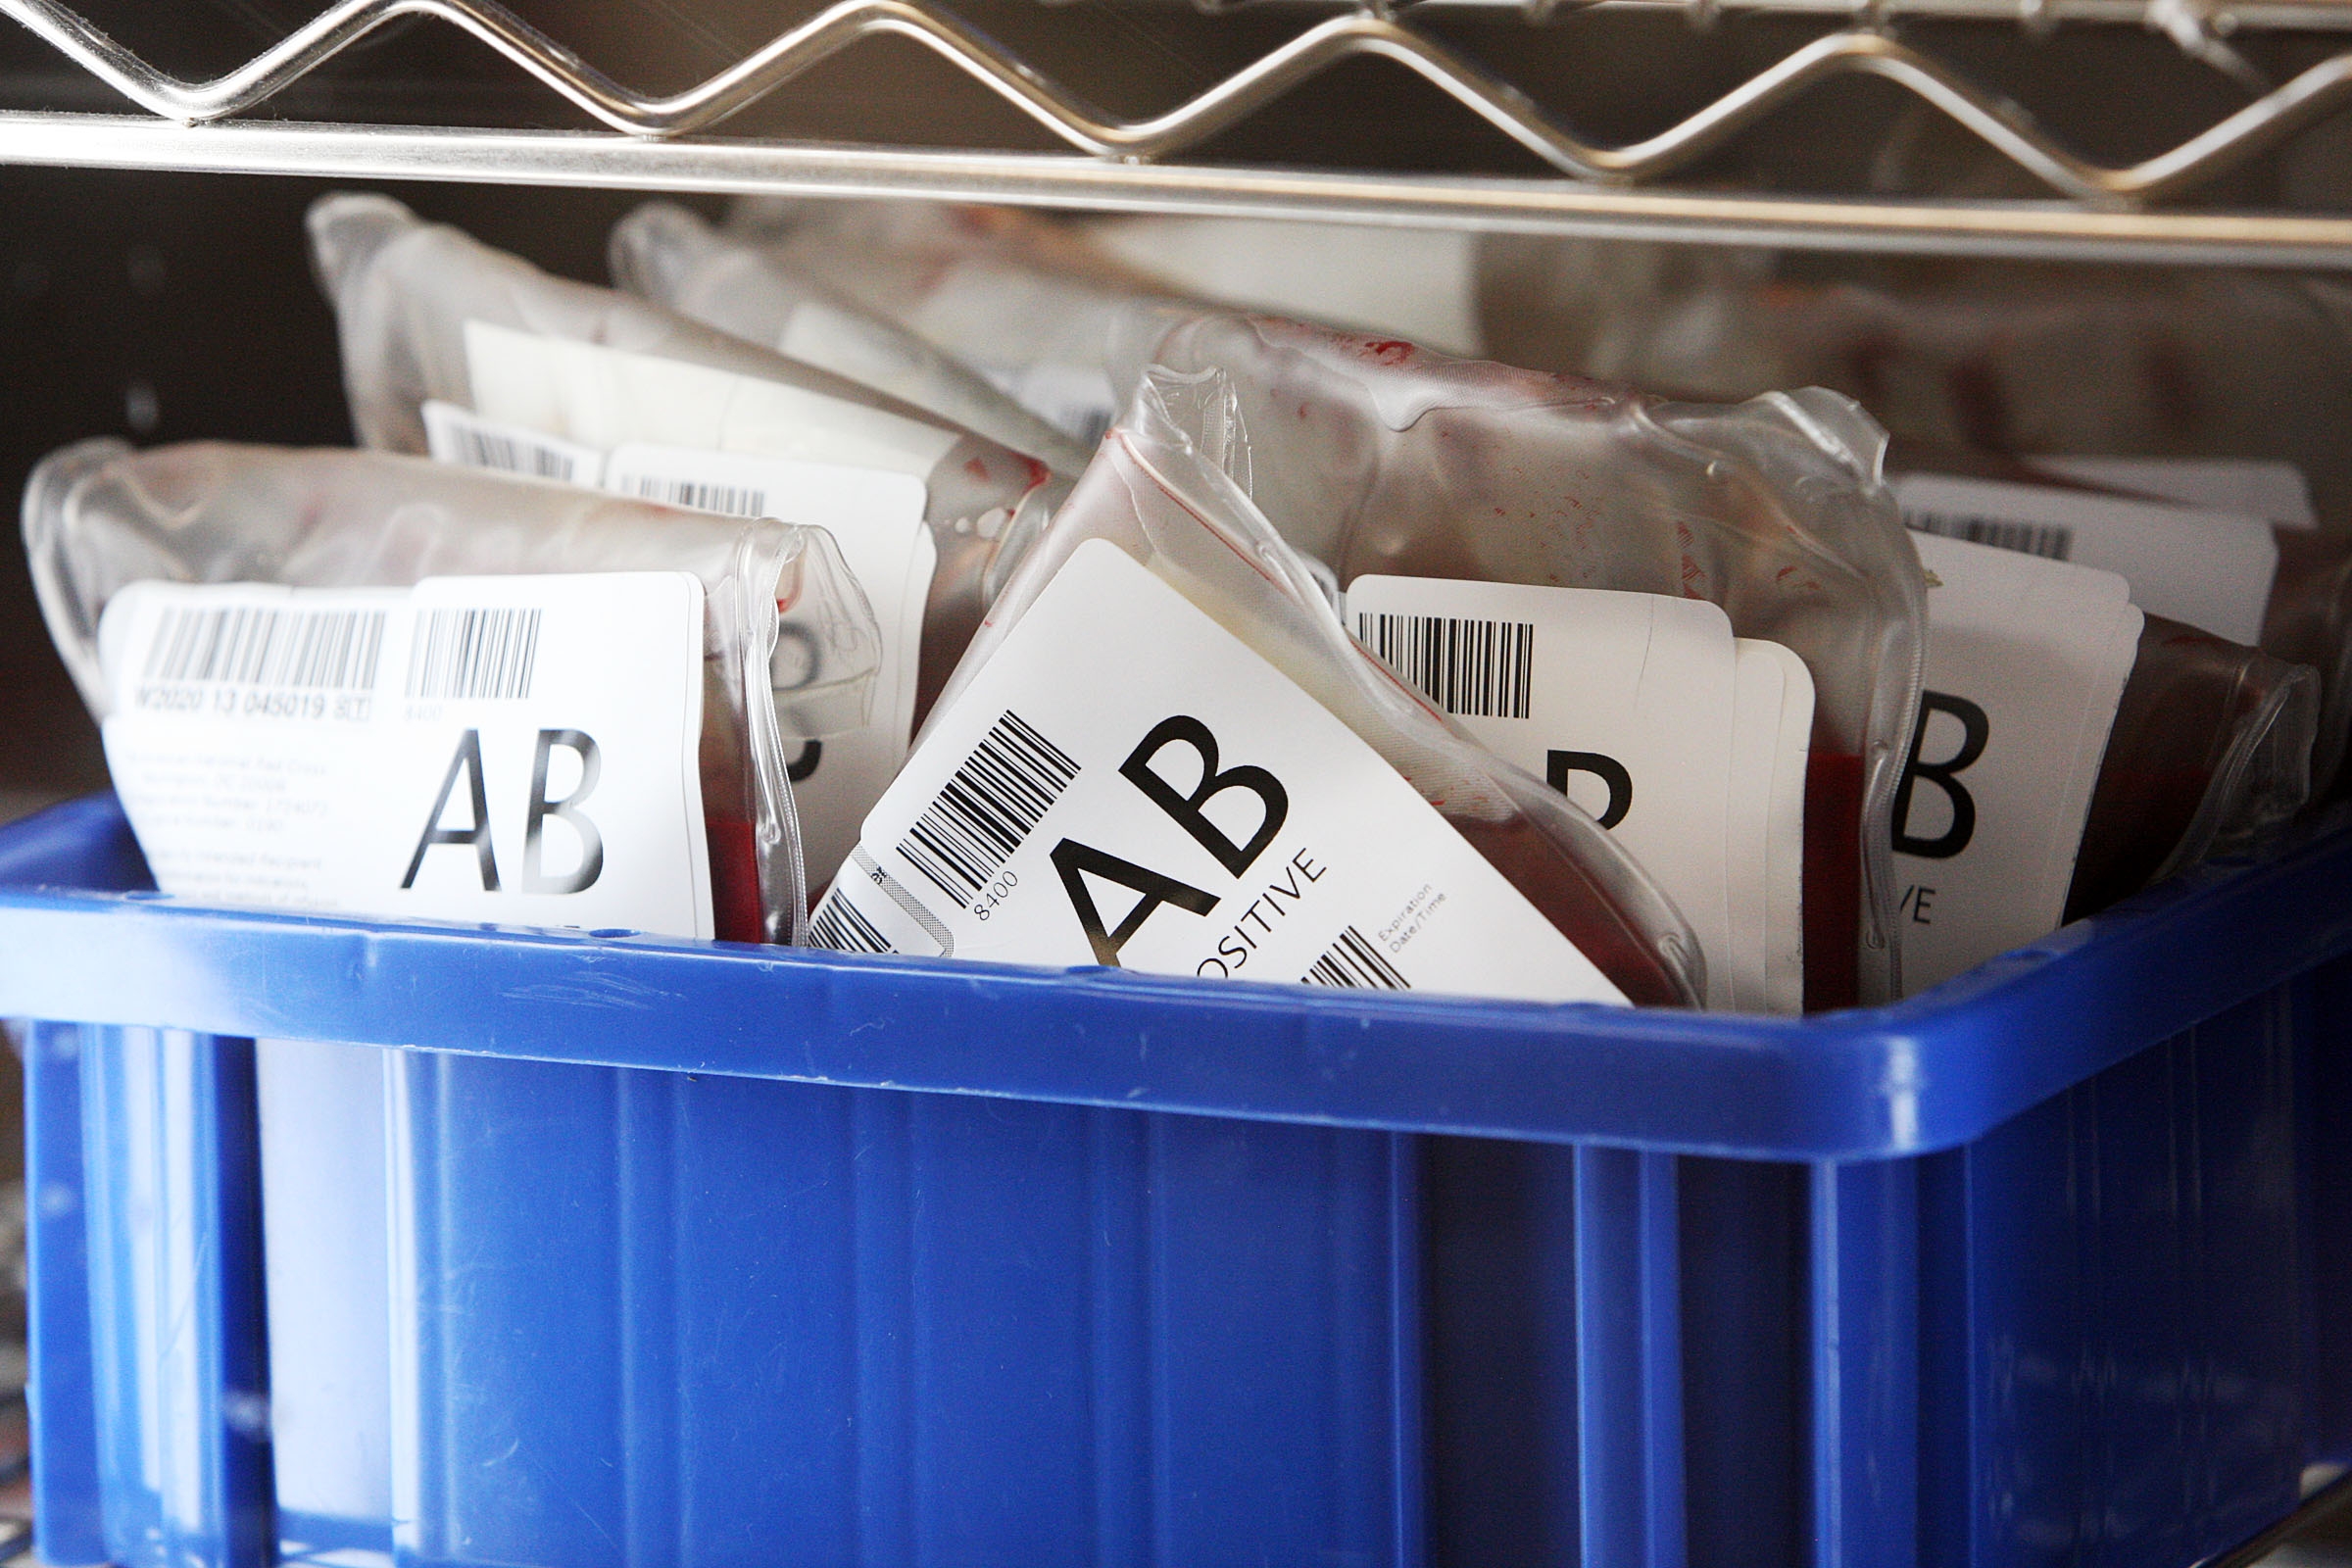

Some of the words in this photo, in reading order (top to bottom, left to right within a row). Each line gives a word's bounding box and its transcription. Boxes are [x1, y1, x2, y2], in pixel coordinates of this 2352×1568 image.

[400, 728, 604, 894] AB
[1891, 689, 1990, 858] B
[973, 870, 1018, 921] 8400
[1050, 714, 1289, 966] AB
[1378, 884, 1432, 942] Expiration
[1389, 893, 1446, 954] Date/Time
